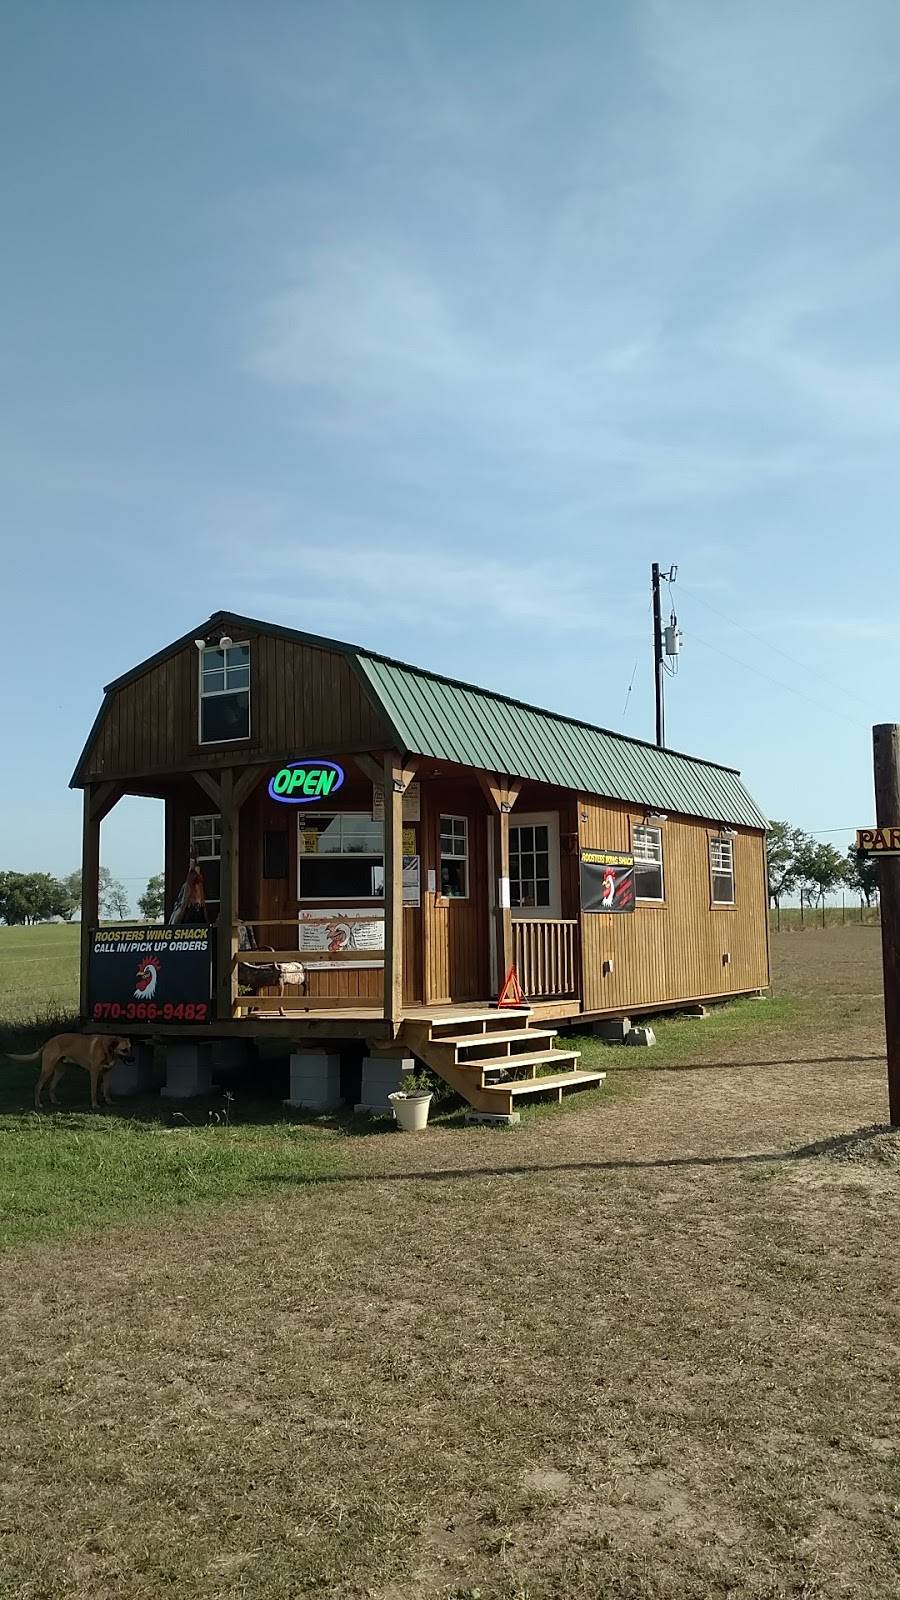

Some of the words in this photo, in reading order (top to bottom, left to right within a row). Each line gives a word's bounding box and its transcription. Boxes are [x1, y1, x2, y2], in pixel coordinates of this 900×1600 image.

[273, 768, 336, 796] OPEN
[581, 852, 605, 864] ROOSTERS
[605, 854, 619, 865] WING
[619, 855, 633, 866] SHACK
[94, 930, 145, 942] ROOSTERS
[146, 929, 173, 941] WING
[173, 928, 208, 940] SHACK
[94, 943, 115, 953] CALL
[153, 941, 168, 952] UP
[168, 941, 208, 952] ORDERS
[93, 1003, 208, 1020] 970-366-9482
